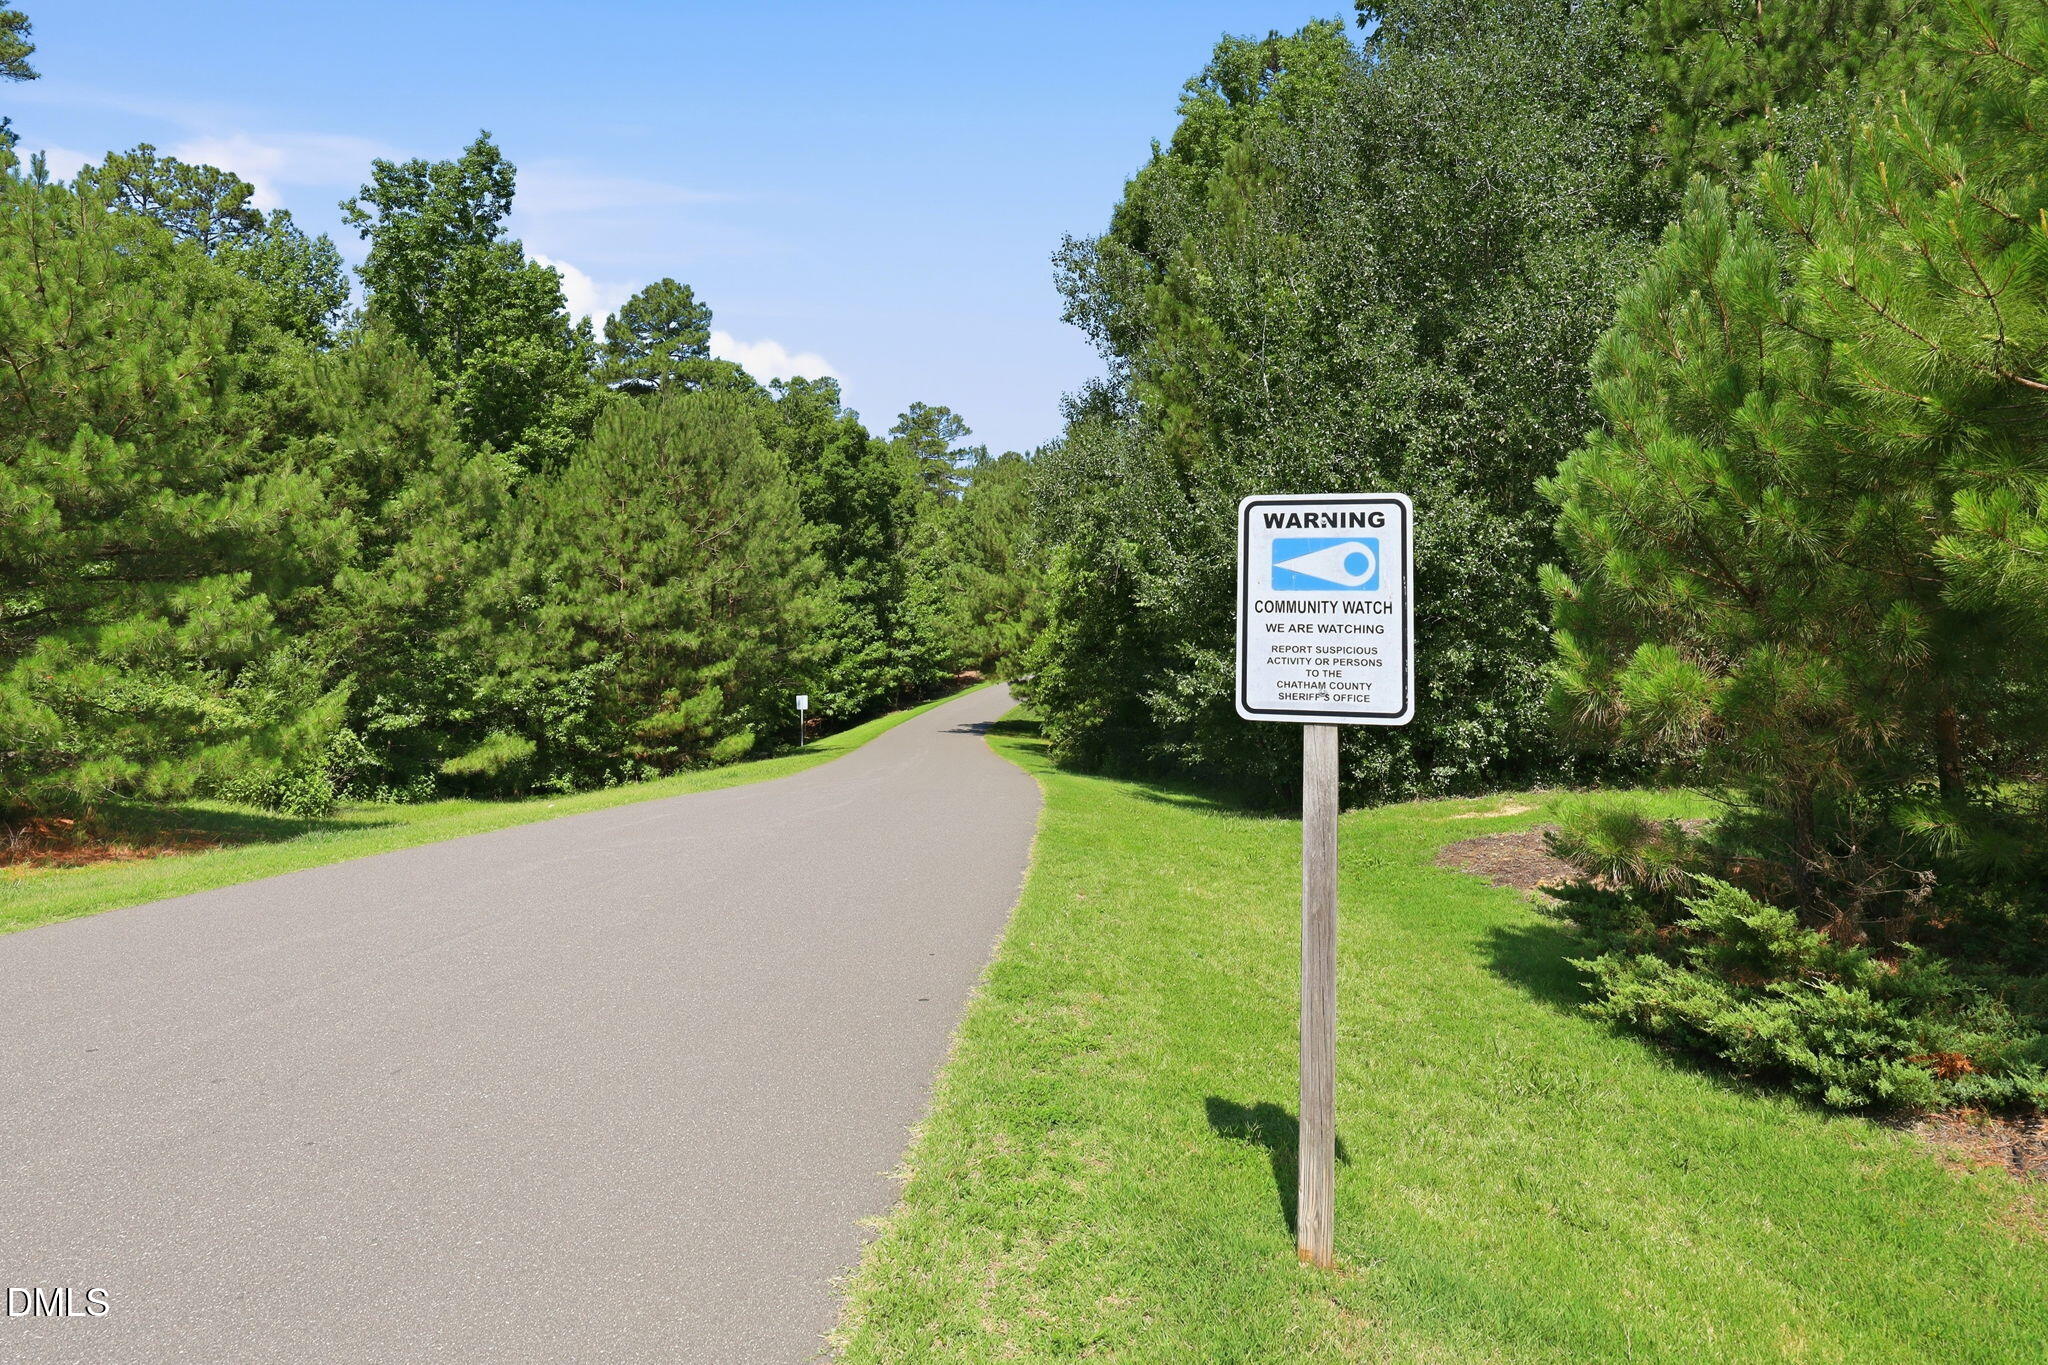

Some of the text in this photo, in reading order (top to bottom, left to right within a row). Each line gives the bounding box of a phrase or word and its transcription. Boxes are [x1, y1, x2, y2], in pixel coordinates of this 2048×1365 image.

[1263, 511, 1386, 529] WARNING
[1254, 599, 1393, 615] COMMUNITY WATCH
[1265, 623, 1385, 635] WE ARE WATCHING
[1271, 645, 1378, 655] REPORT SUSPICIOUS
[1266, 657, 1383, 667] ACTIVITY OR PERSONS
[1306, 669, 1342, 678] TO THE
[1276, 680, 1372, 691] CHATHAM COUNTY
[1278, 692, 1371, 703] SHERIFFS OFFICE
